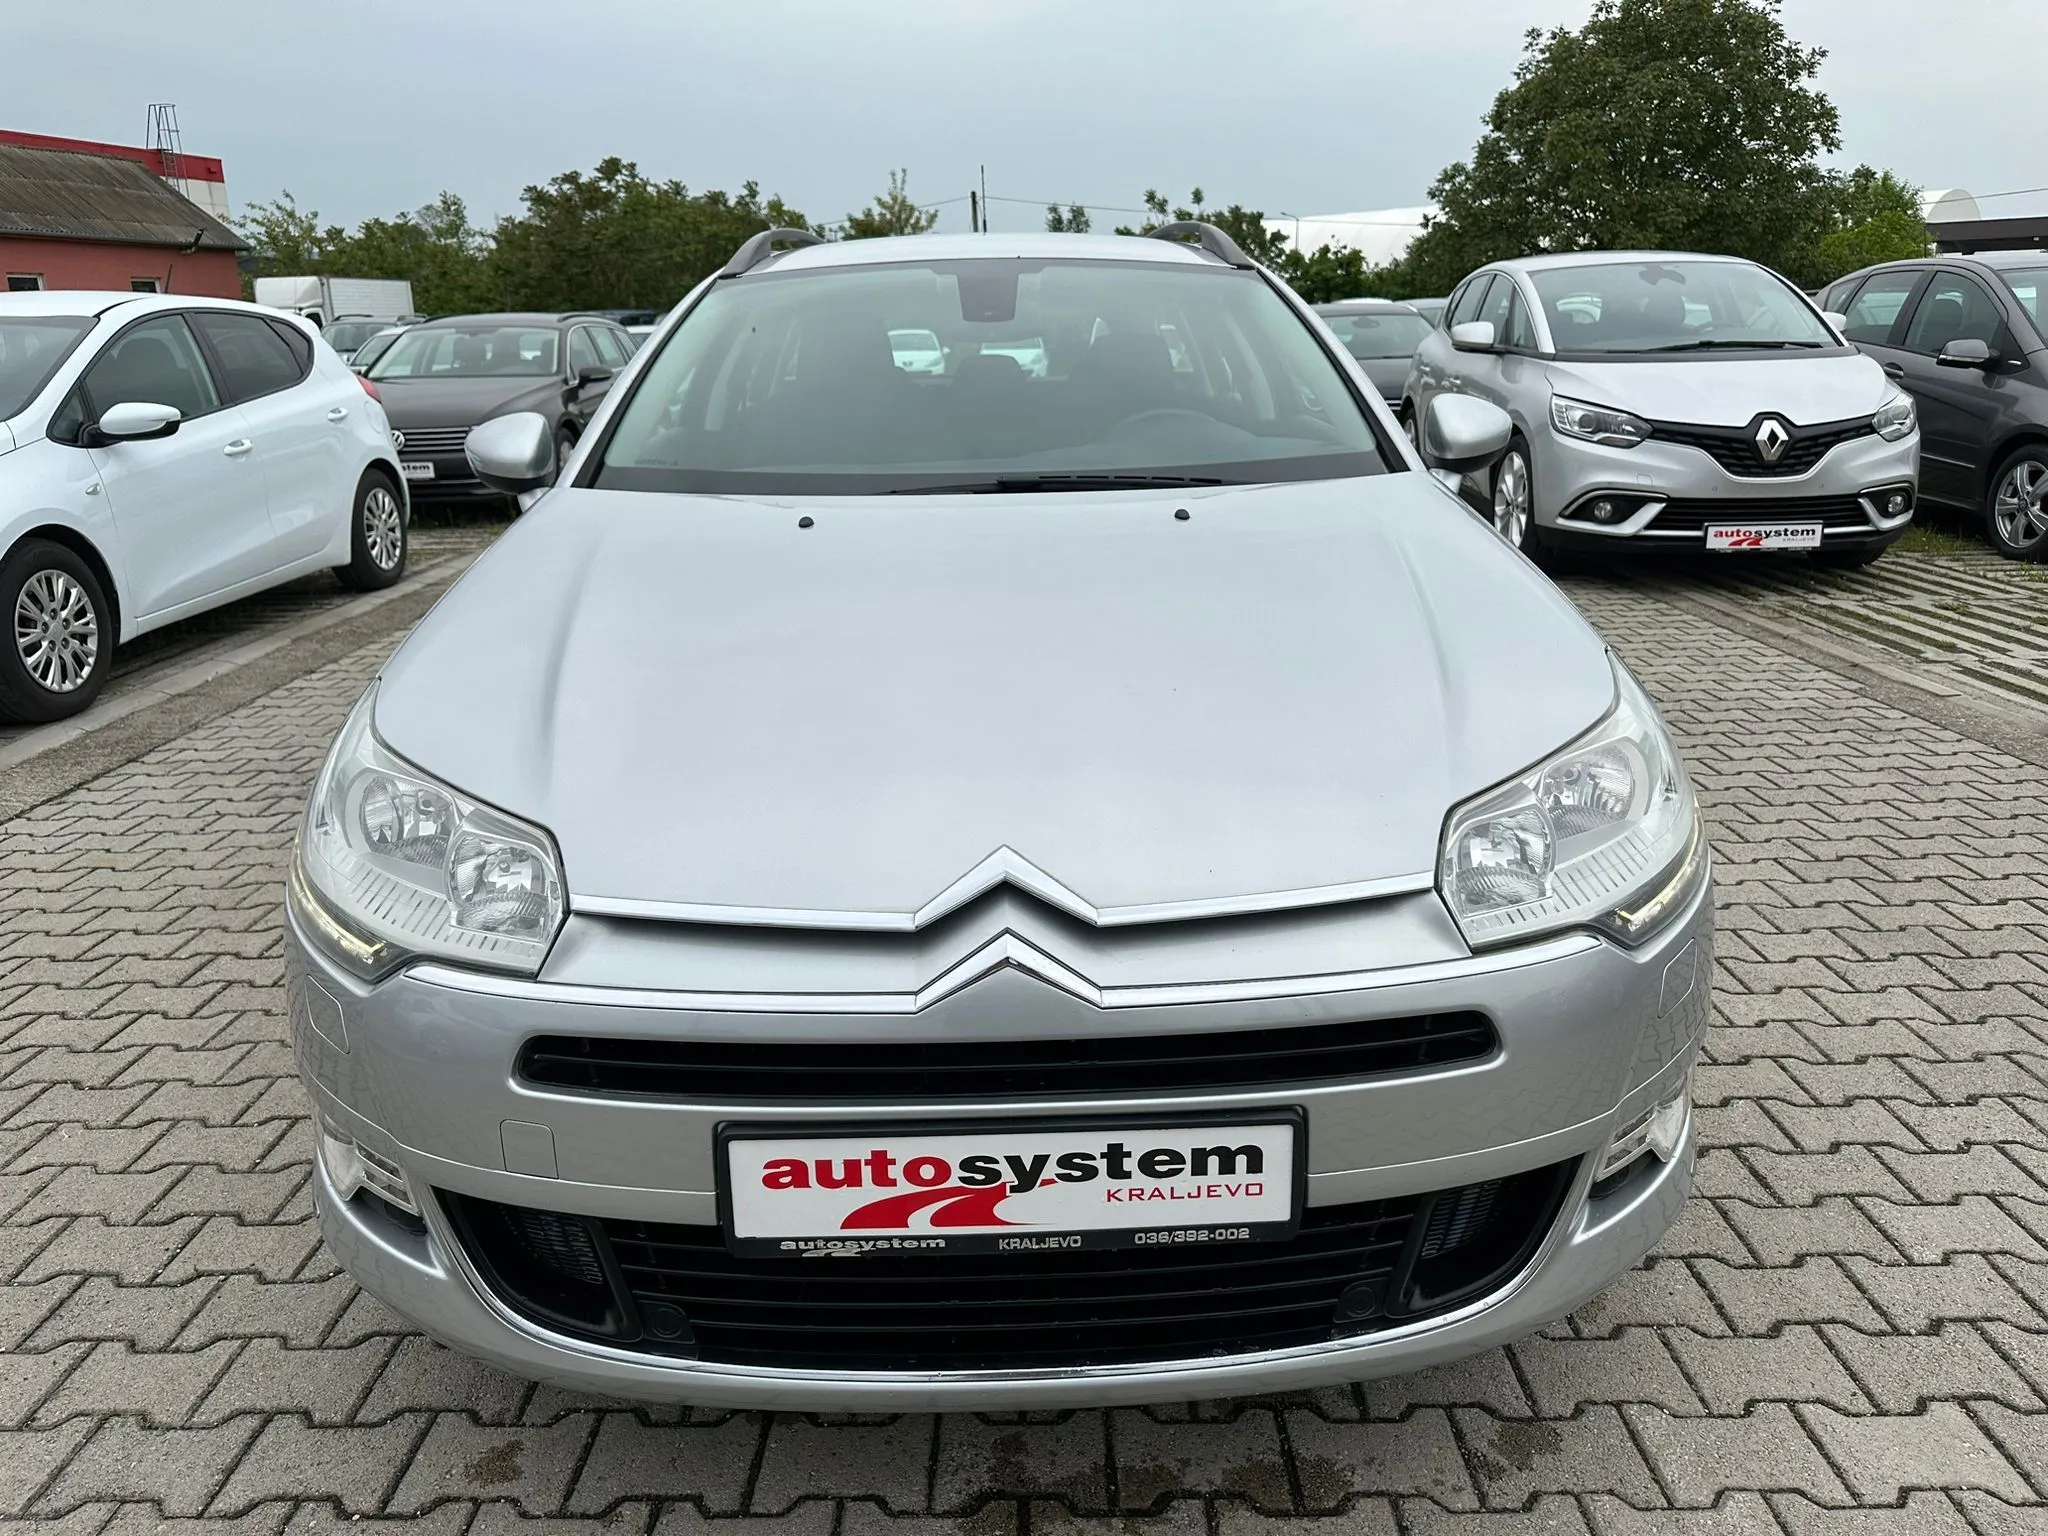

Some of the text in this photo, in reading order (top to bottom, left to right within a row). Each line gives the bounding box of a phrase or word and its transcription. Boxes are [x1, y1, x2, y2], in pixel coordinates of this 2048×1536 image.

[1713, 528, 1816, 539] autosystem
[761, 1143, 1264, 1194] autosystem
[1106, 1182, 1264, 1202] KRALJEVO
[780, 1228, 1250, 1252] autosystem KRALJEVO 036/392-002
